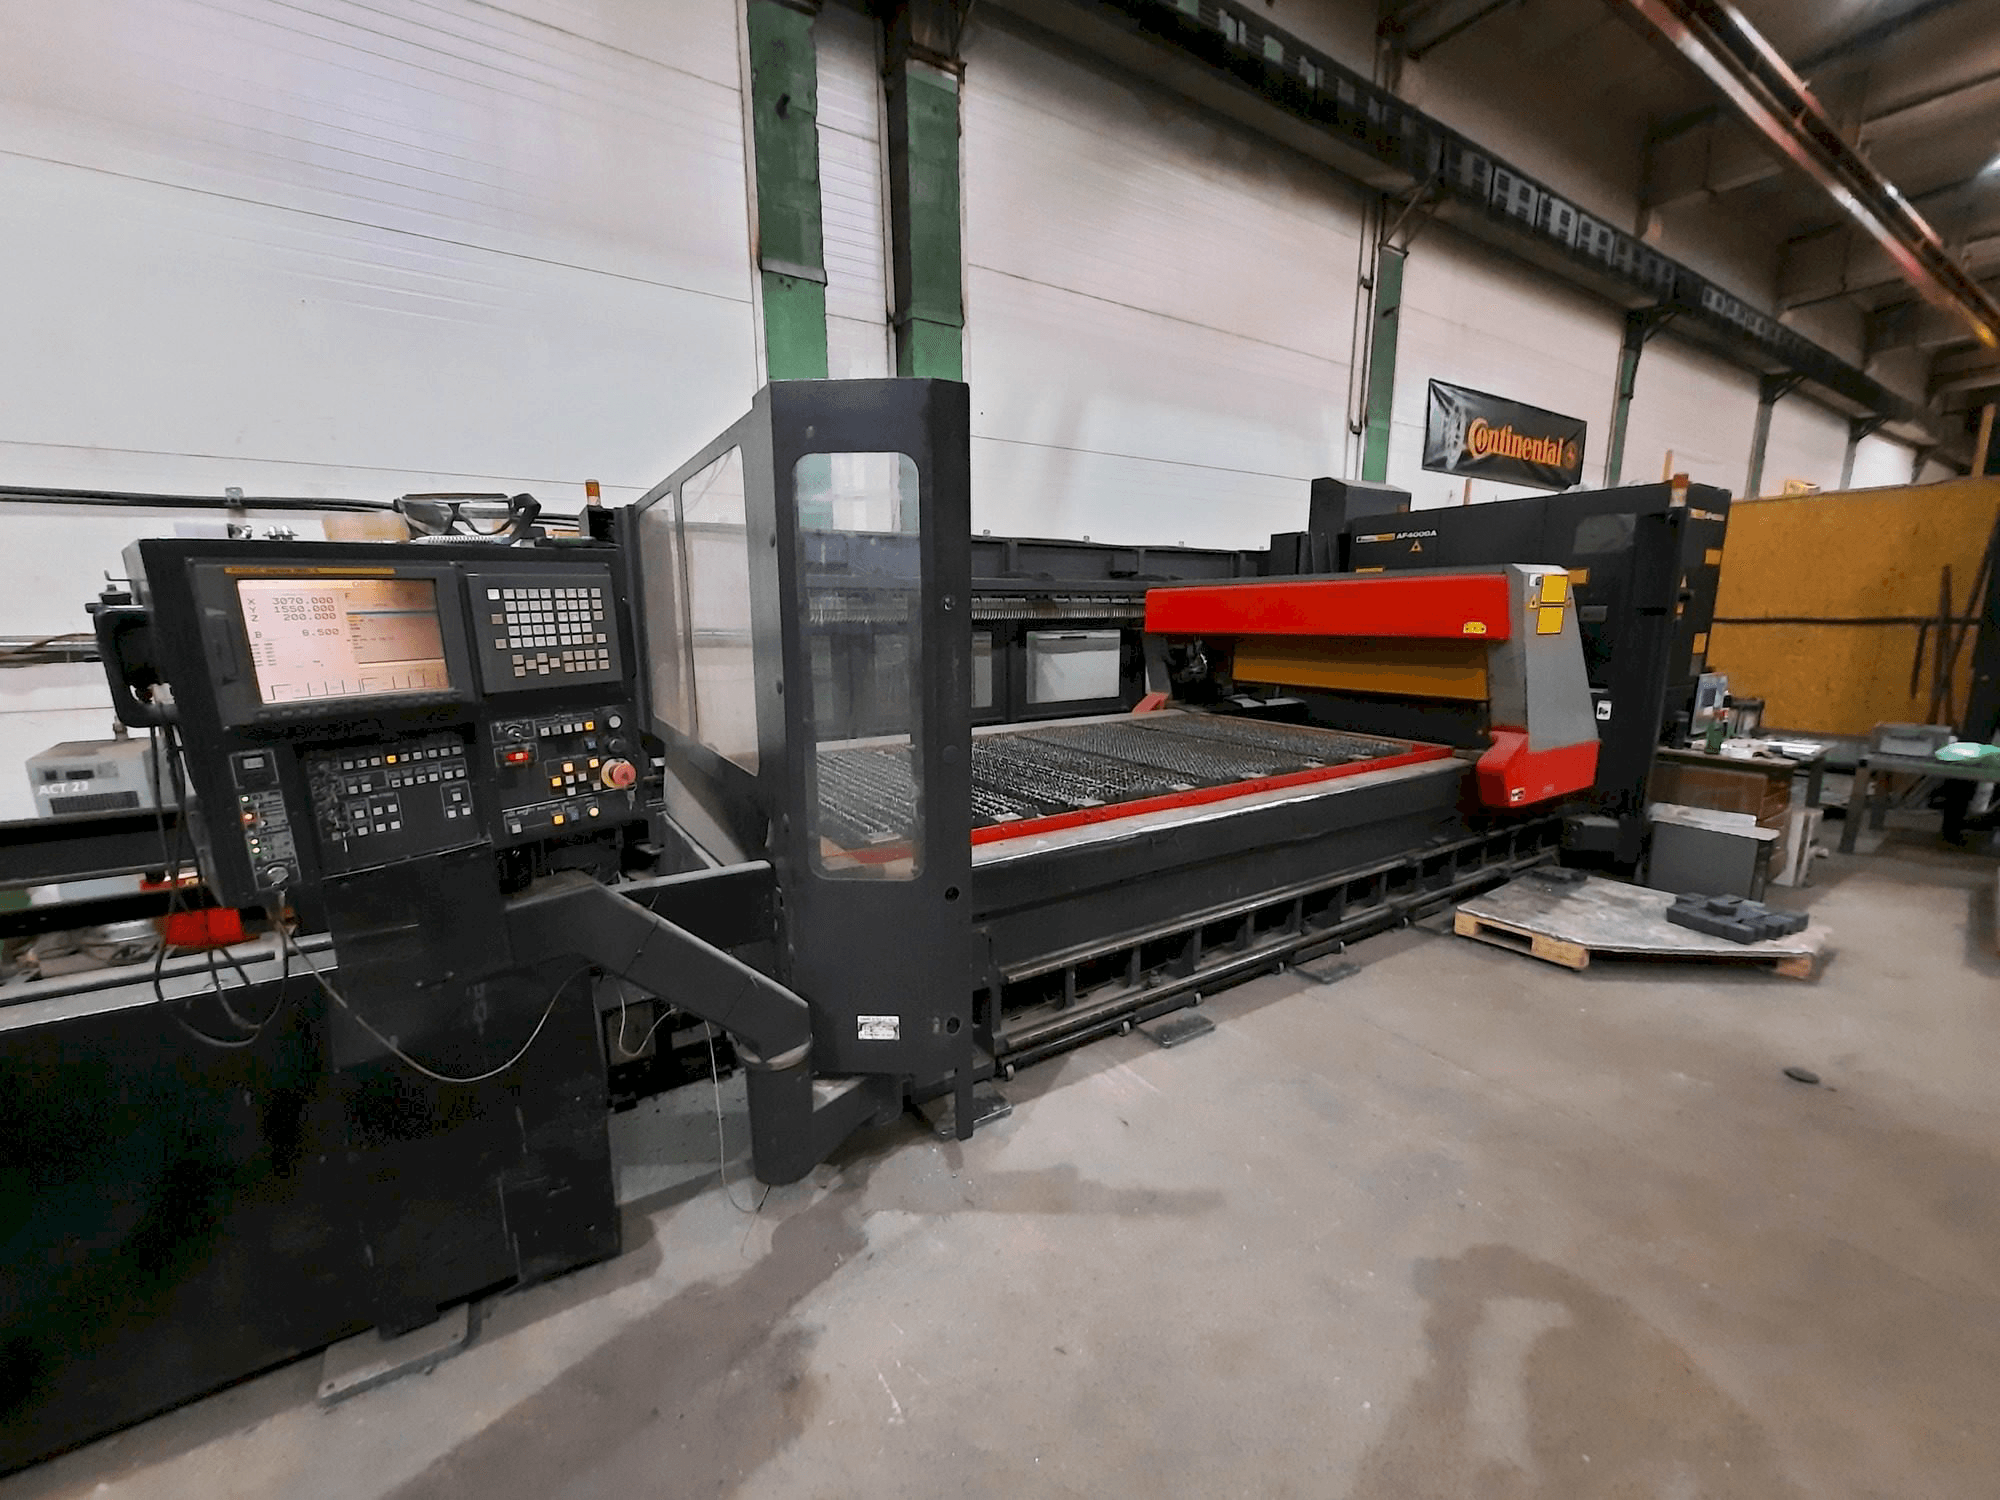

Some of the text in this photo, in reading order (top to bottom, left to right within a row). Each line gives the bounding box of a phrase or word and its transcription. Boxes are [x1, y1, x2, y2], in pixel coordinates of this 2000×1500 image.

[1467, 417, 1564, 467] Continental
[272, 597, 334, 605] 3070.000
[249, 605, 336, 614] Y 1550.000
[283, 613, 337, 621] 200.000
[39, 780, 89, 796] ACT 23
